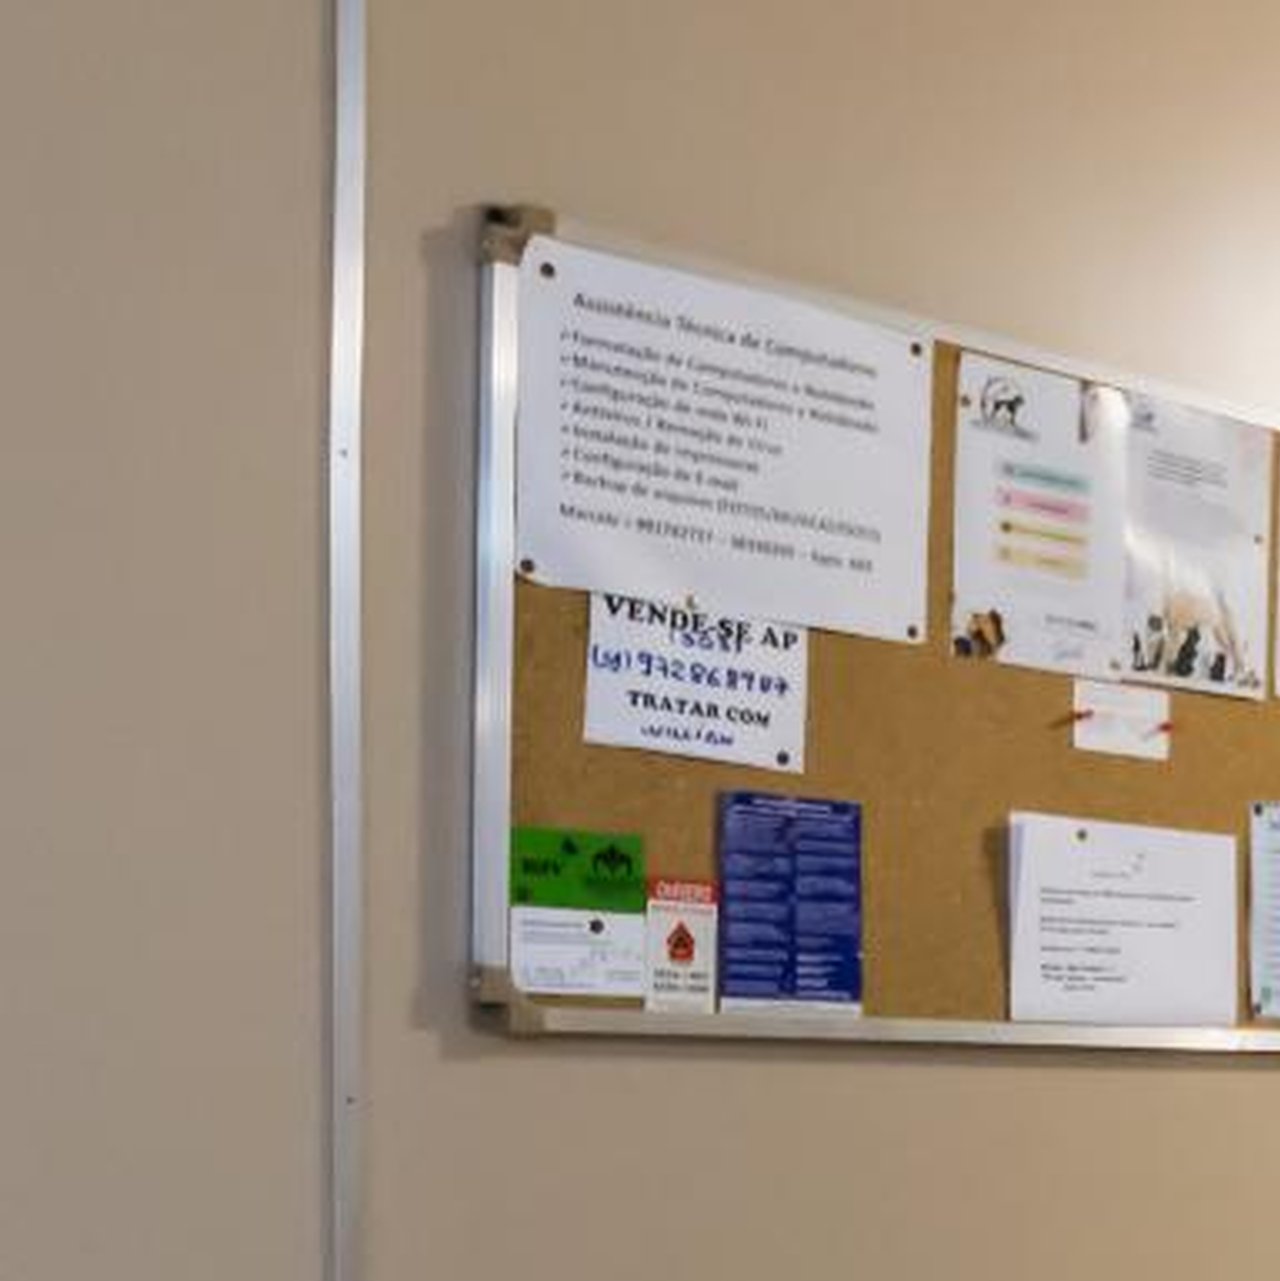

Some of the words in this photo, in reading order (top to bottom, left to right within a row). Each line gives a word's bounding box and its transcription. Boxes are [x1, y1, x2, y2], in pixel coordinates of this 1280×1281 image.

[740, 331, 760, 349] de
[603, 592, 755, 643] VENDE-SE
[760, 625, 799, 652] AP
[625, 689, 721, 721] TRATAR
[726, 705, 771, 731] COM
